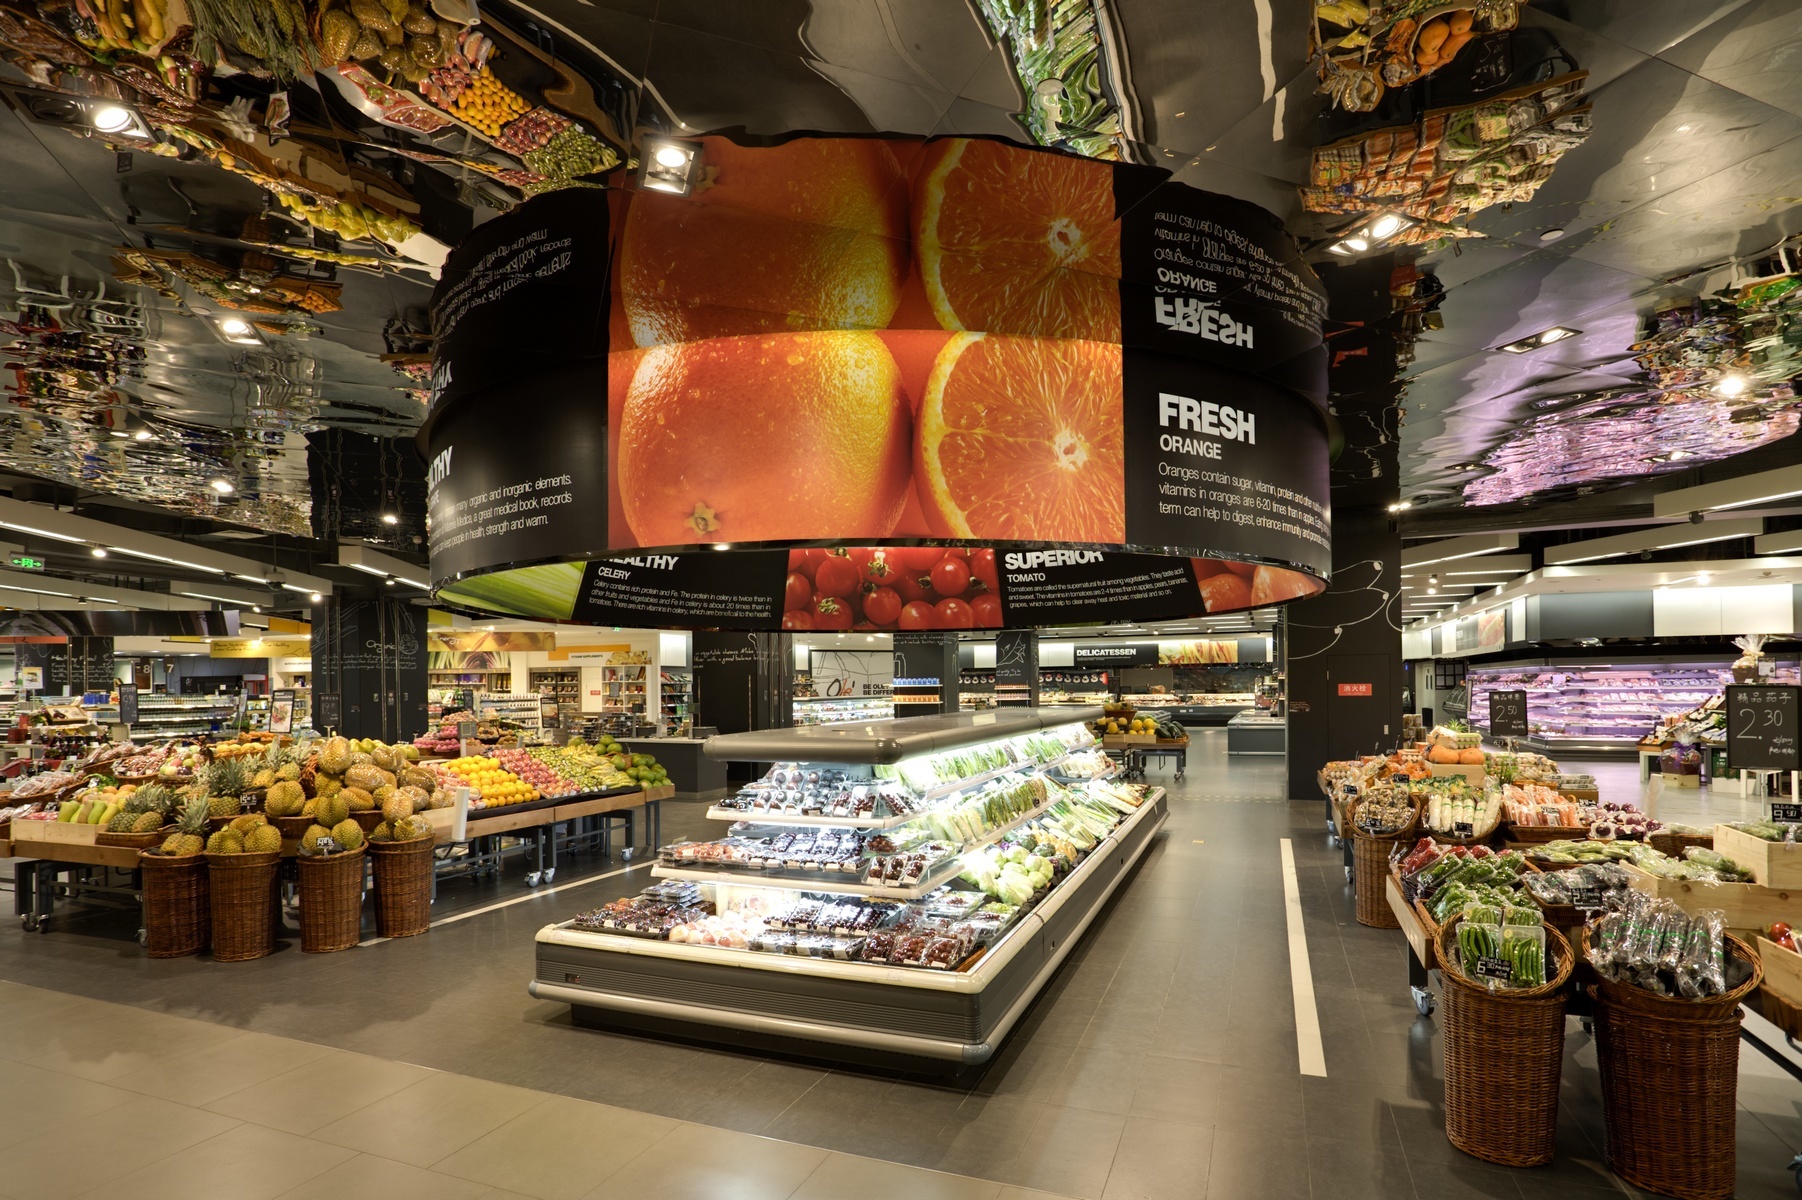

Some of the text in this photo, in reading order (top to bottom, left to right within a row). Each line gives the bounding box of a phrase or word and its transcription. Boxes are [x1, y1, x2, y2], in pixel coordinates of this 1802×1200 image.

[1159, 392, 1256, 445] FRESH
[1160, 434, 1222, 460] ORANGE
[469, 492, 488, 508] organic
[490, 486, 502, 500] and
[503, 480, 532, 498] inorganic
[535, 474, 572, 490] elements.
[1158, 462, 1200, 481] Oranges
[1201, 472, 1230, 485] contain
[1232, 476, 1254, 491] sugar,
[1254, 480, 1277, 498] vitamin,
[1277, 487, 1294, 500] protein
[474, 514, 478, 522] a
[478, 508, 493, 524] great
[494, 500, 518, 516] medical
[520, 496, 540, 511] book,
[541, 491, 572, 507] records
[1159, 482, 1196, 498] vitamins
[1200, 486, 1206, 499] in
[1209, 490, 1241, 506] oranges
[1242, 496, 1254, 508] are
[1256, 497, 1271, 511] 6-20
[1272, 501, 1287, 516] times
[470, 524, 486, 539] health,
[486, 520, 510, 536] strength
[510, 517, 524, 530] and
[525, 514, 548, 528] warm.
[1159, 502, 1182, 514] term
[1184, 506, 1201, 517] can
[1203, 506, 1220, 522] help
[1222, 509, 1230, 521] to
[1232, 511, 1255, 526] digest,
[1256, 516, 1282, 530] enhance
[1282, 520, 1302, 538] immunity
[1004, 550, 1104, 570] SUPERIOR
[598, 566, 632, 580] CELERY
[1006, 572, 1046, 583] TOMATO
[1008, 584, 1034, 592] Tomatoes
[1066, 580, 1096, 590] supernatural
[1124, 574, 1150, 584] vegetables.
[1150, 572, 1162, 580] They
[590, 588, 604, 596] other
[605, 590, 618, 599] fruits
[630, 594, 658, 604] vegetables
[685, 600, 702, 608] celery
[594, 579, 610, 590] Celery
[610, 582, 630, 592] contains
[640, 586, 658, 595] protein
[680, 590, 690, 598] The
[716, 594, 732, 602] celery
[1028, 600, 1044, 608] which
[1054, 599, 1065, 608] help
[1084, 597, 1096, 605] away
[1130, 592, 1148, 600] material
[1070, 590, 1094, 598] tomatoes
[614, 600, 627, 608] There
[646, 604, 666, 613] vitamins
[1076, 648, 1136, 656] DELICATESSEN
[143, 664, 150, 674] 8
[166, 664, 174, 673] 7
[1344, 684, 1366, 692] 消火栓
